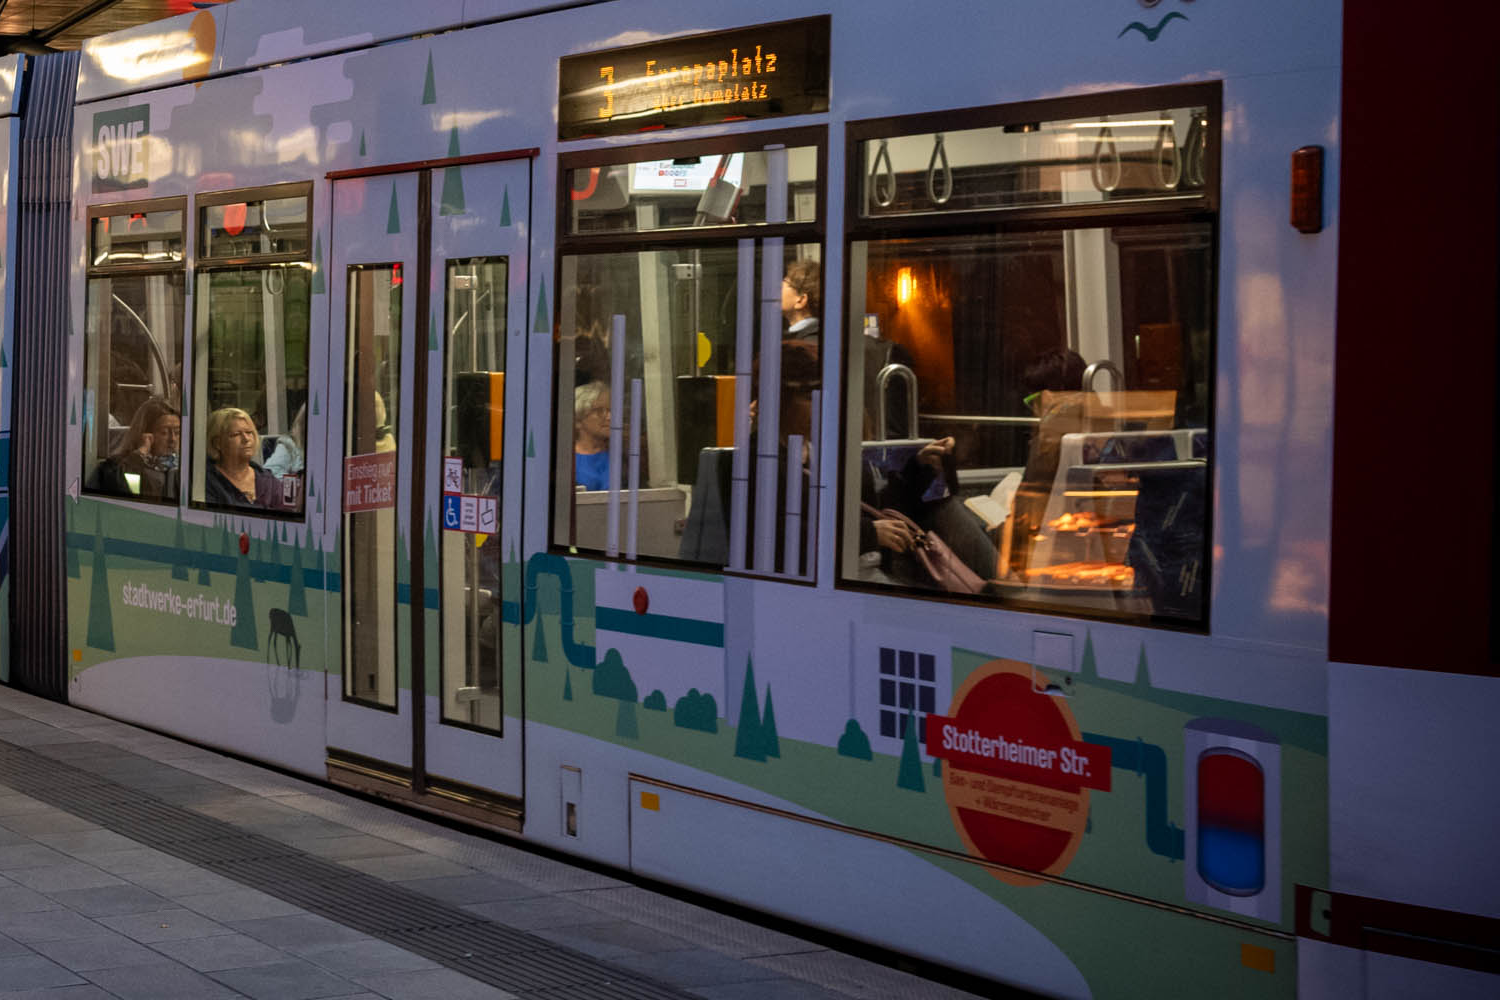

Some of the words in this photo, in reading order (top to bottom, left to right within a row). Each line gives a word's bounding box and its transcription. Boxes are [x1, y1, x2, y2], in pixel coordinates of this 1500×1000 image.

[599, 66, 615, 119] 3
[693, 81, 768, 105] Domplatz
[97, 119, 145, 180] SWE
[347, 462, 377, 483] Einstieg
[378, 461, 393, 478] nur
[347, 486, 362, 506] mit
[364, 481, 392, 504] Ticket
[122, 580, 237, 628] stadtwerke-erfurt.de
[941, 724, 1058, 770] Stotterheimer
[1059, 746, 1092, 778] Str.
